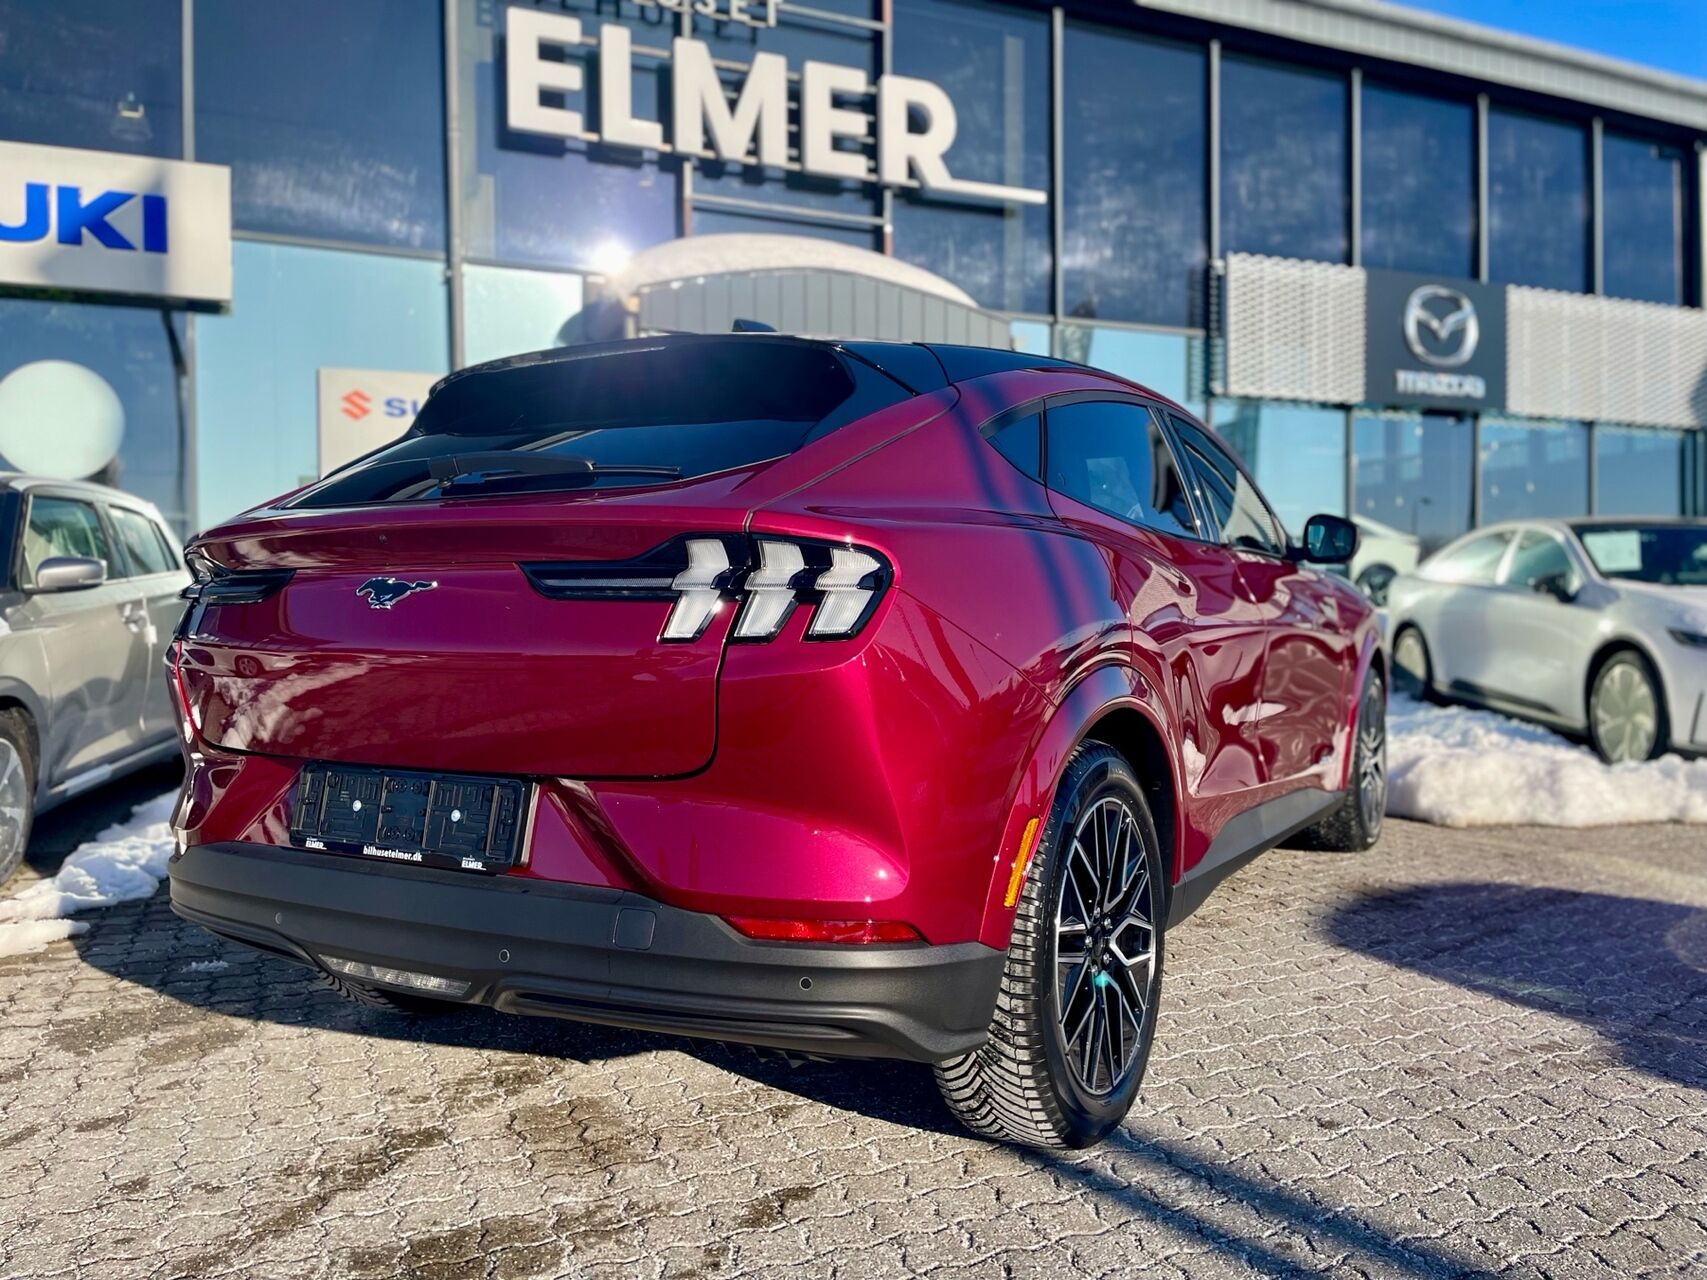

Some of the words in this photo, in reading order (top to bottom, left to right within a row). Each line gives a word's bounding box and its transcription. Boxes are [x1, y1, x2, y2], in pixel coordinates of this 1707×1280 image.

[656, 0, 782, 27] SET
[506, 5, 1047, 204] ELMER
[0, 182, 168, 254] UKI
[305, 840, 327, 850] ELMER
[362, 845, 423, 862] bilhusetelmer.dk
[461, 860, 487, 870] ELMER
